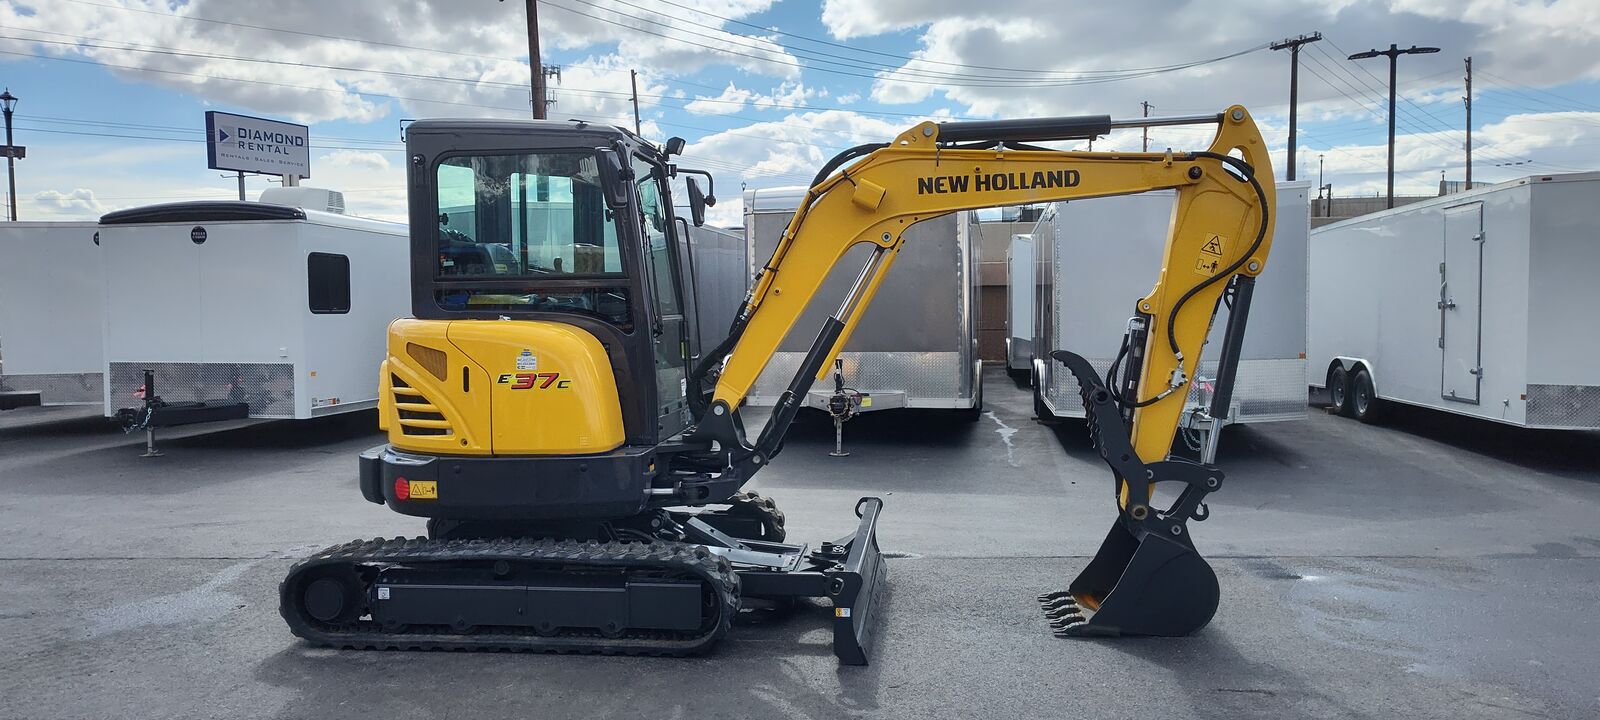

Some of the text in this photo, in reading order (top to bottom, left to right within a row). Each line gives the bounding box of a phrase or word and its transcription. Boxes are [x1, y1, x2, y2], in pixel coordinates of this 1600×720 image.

[238, 128, 304, 147] DIAMOND
[238, 141, 289, 155] RENTAL
[918, 169, 1081, 195] NEW HOLLAND
